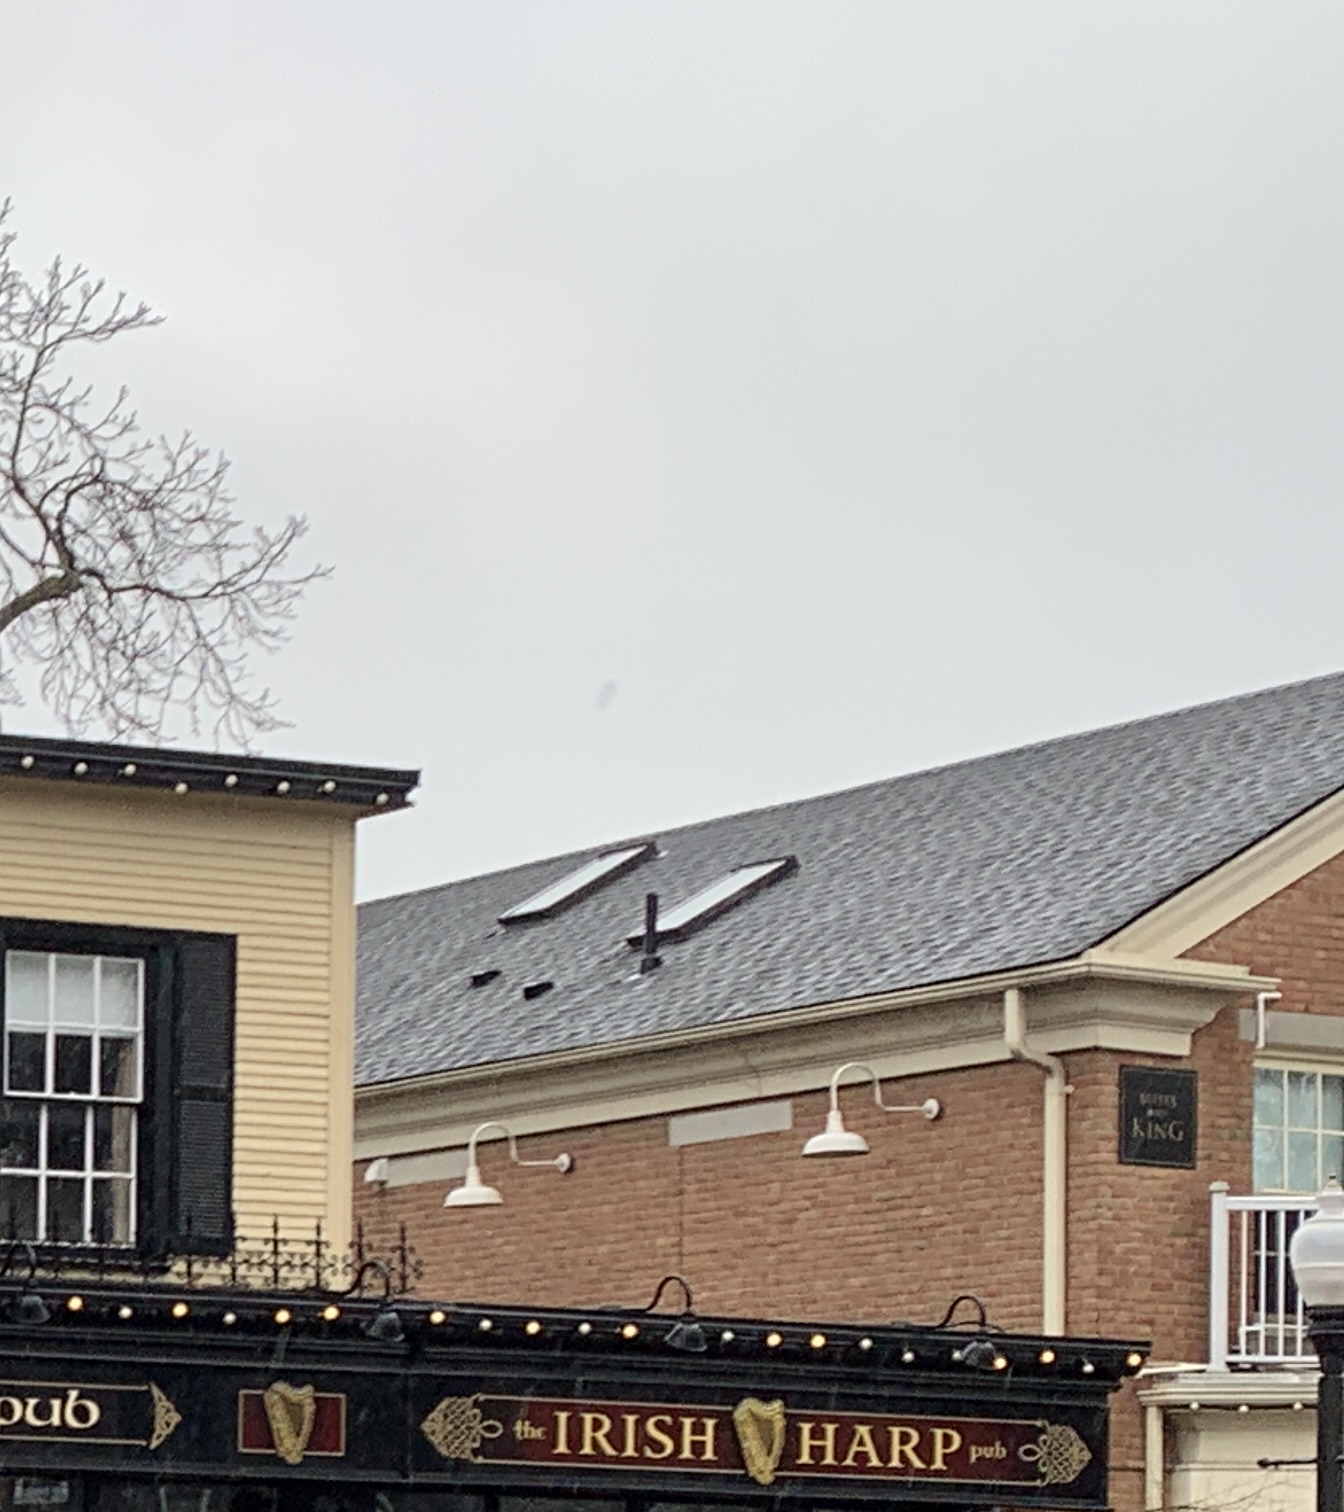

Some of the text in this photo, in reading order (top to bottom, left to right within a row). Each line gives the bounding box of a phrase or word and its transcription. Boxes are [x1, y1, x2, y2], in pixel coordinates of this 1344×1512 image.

[512, 1411, 1008, 1471] the IRISH HARP pub
